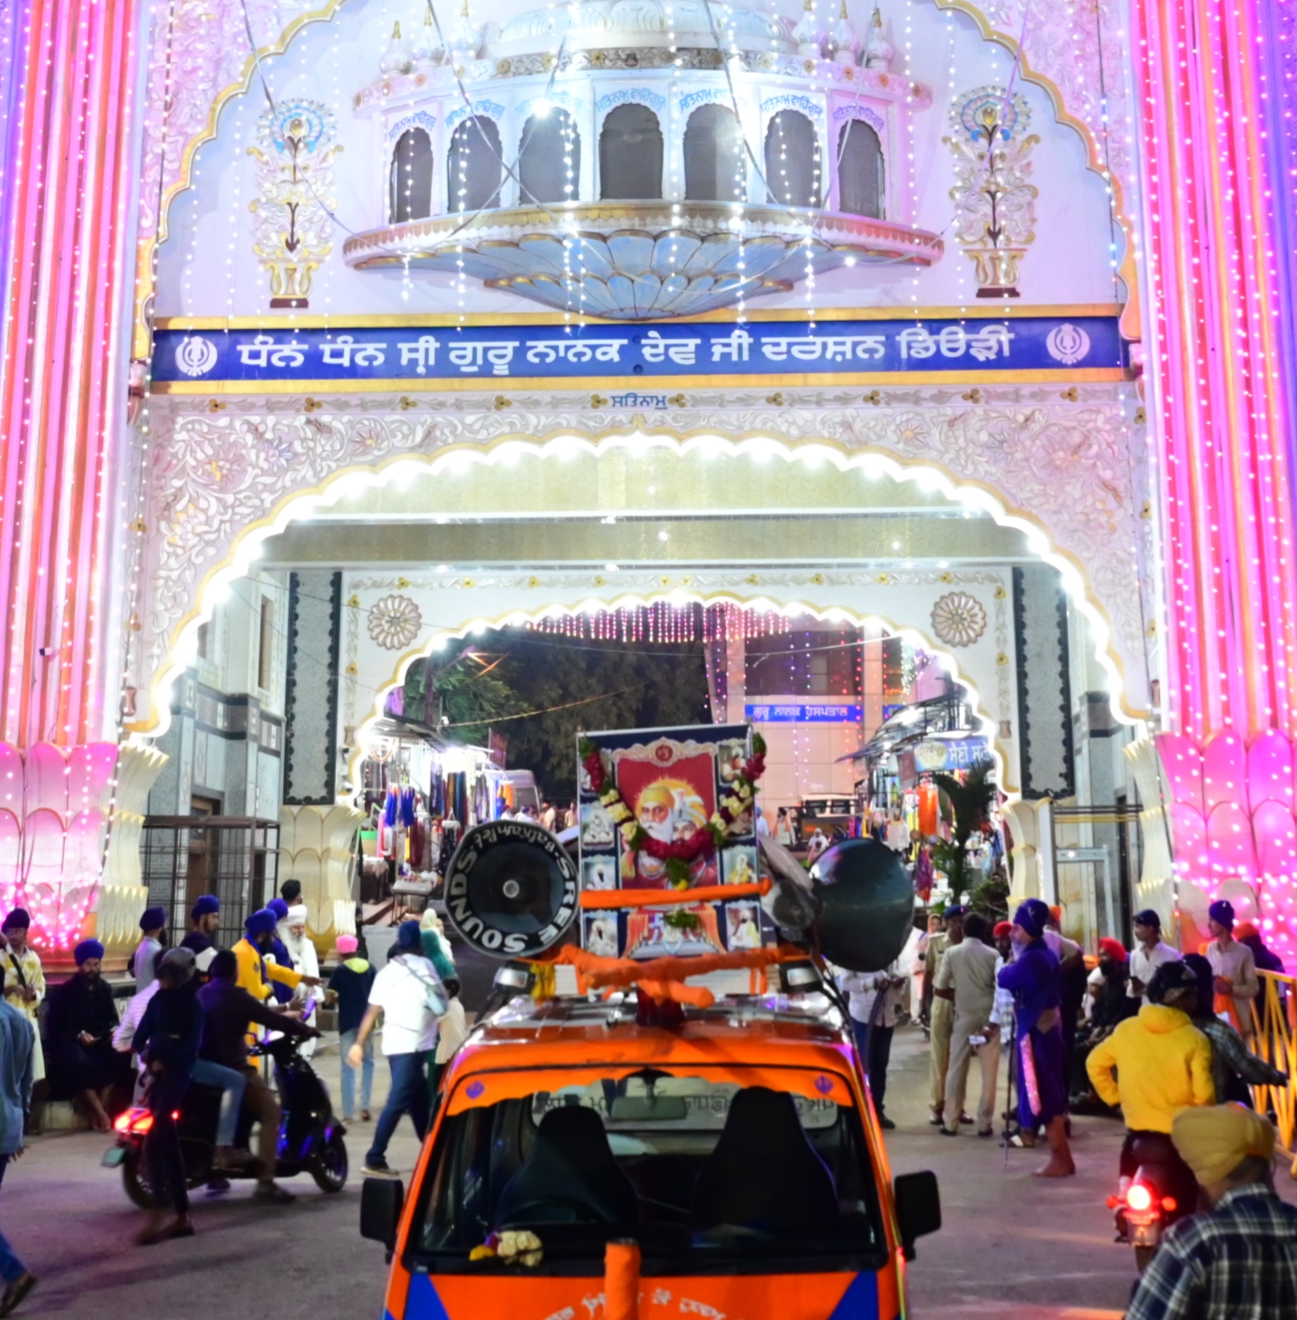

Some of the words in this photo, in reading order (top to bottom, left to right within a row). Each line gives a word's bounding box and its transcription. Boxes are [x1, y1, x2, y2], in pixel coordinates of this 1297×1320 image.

[236, 335, 309, 368] ਧੰਨ
[319, 335, 387, 368] ਧੰਨ
[397, 335, 441, 376] ਸ੍ਰੀ
[448, 340, 520, 376] ਗੁਰੂ
[526, 338, 628, 364] ਨਾਨਕ
[640, 330, 702, 365] ਦੇਵ
[710, 329, 754, 362] ਜੀ
[760, 334, 886, 363] ਦਰਸ਼ਨ
[449, 849, 529, 953] SOUNDS
[537, 856, 577, 946] SREE
